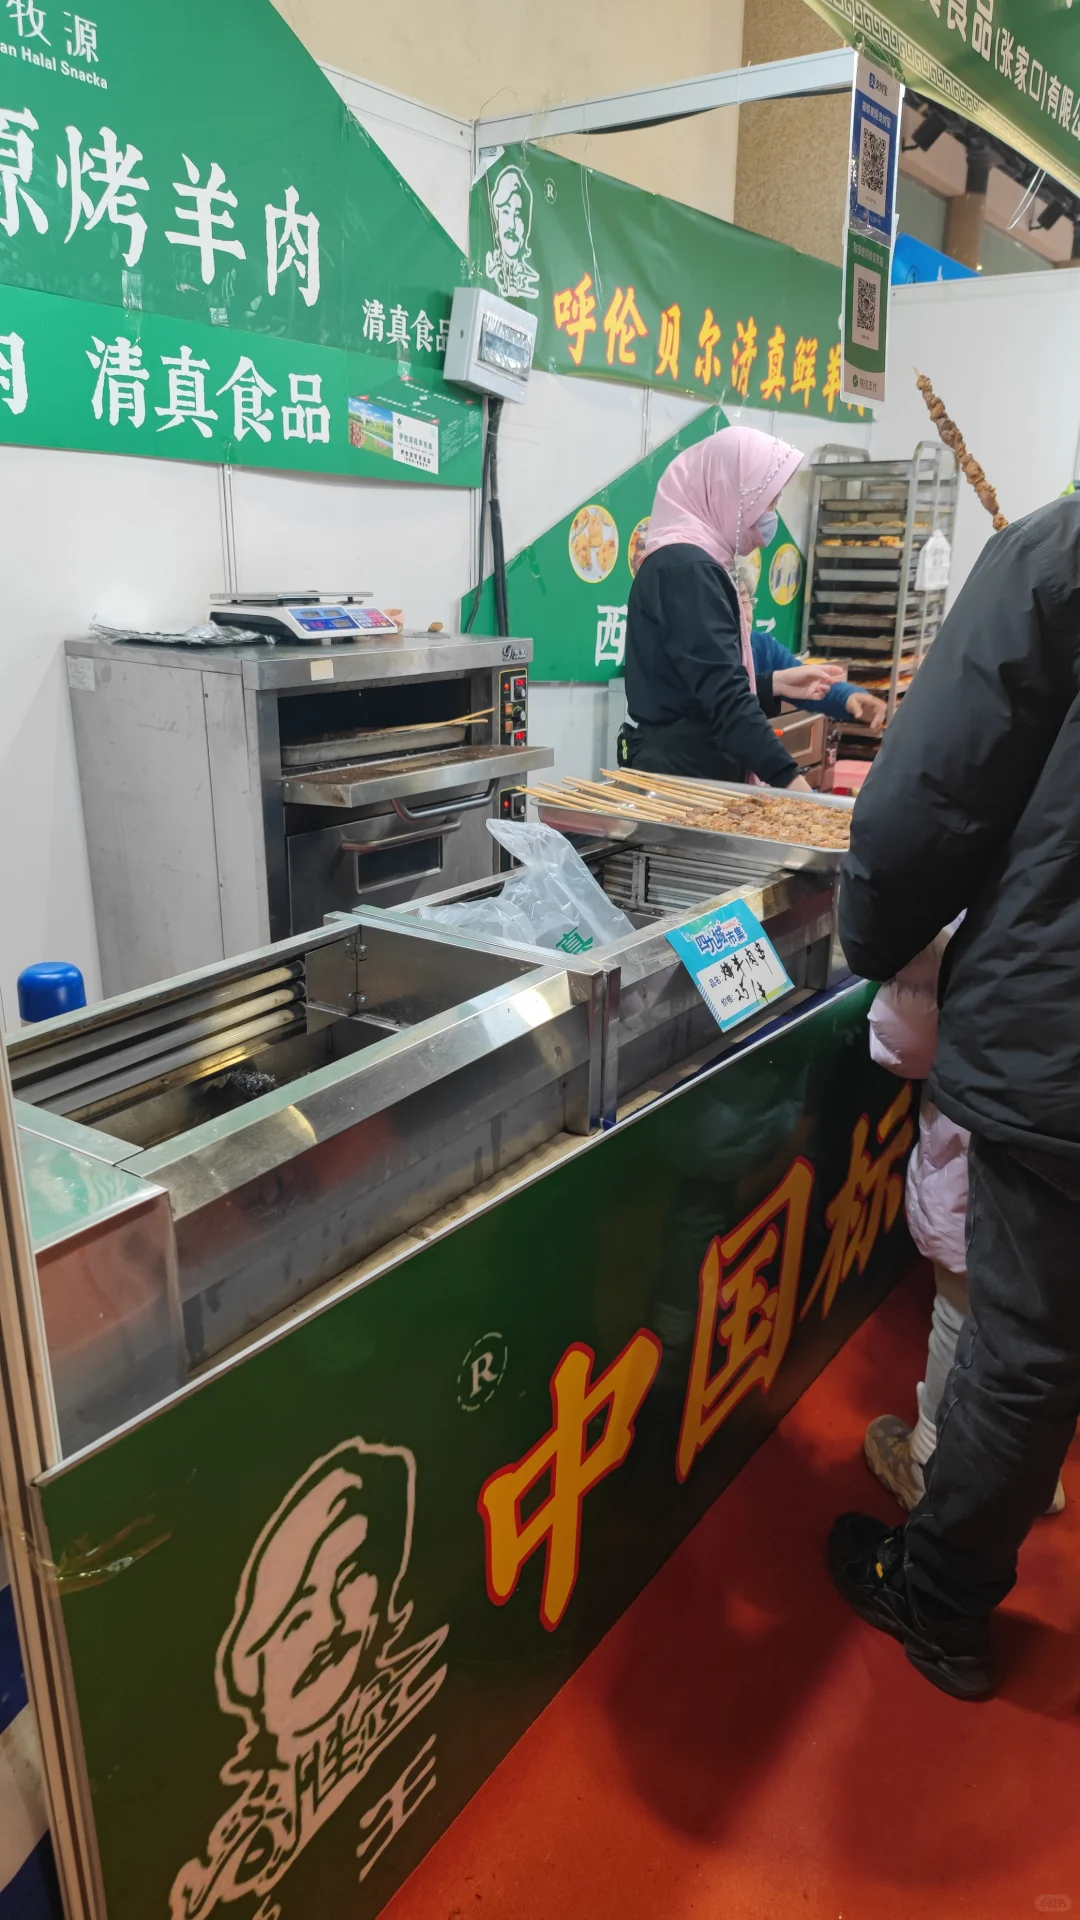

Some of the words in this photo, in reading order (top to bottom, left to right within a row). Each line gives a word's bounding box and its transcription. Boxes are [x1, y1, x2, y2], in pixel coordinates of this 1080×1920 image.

[21, 45, 57, 72] Halal
[60, 60, 108, 90] Snacka
[86, 336, 331, 443] 清真食品
[553, 271, 866, 417] 呼伦贝尔清真鲜羊
